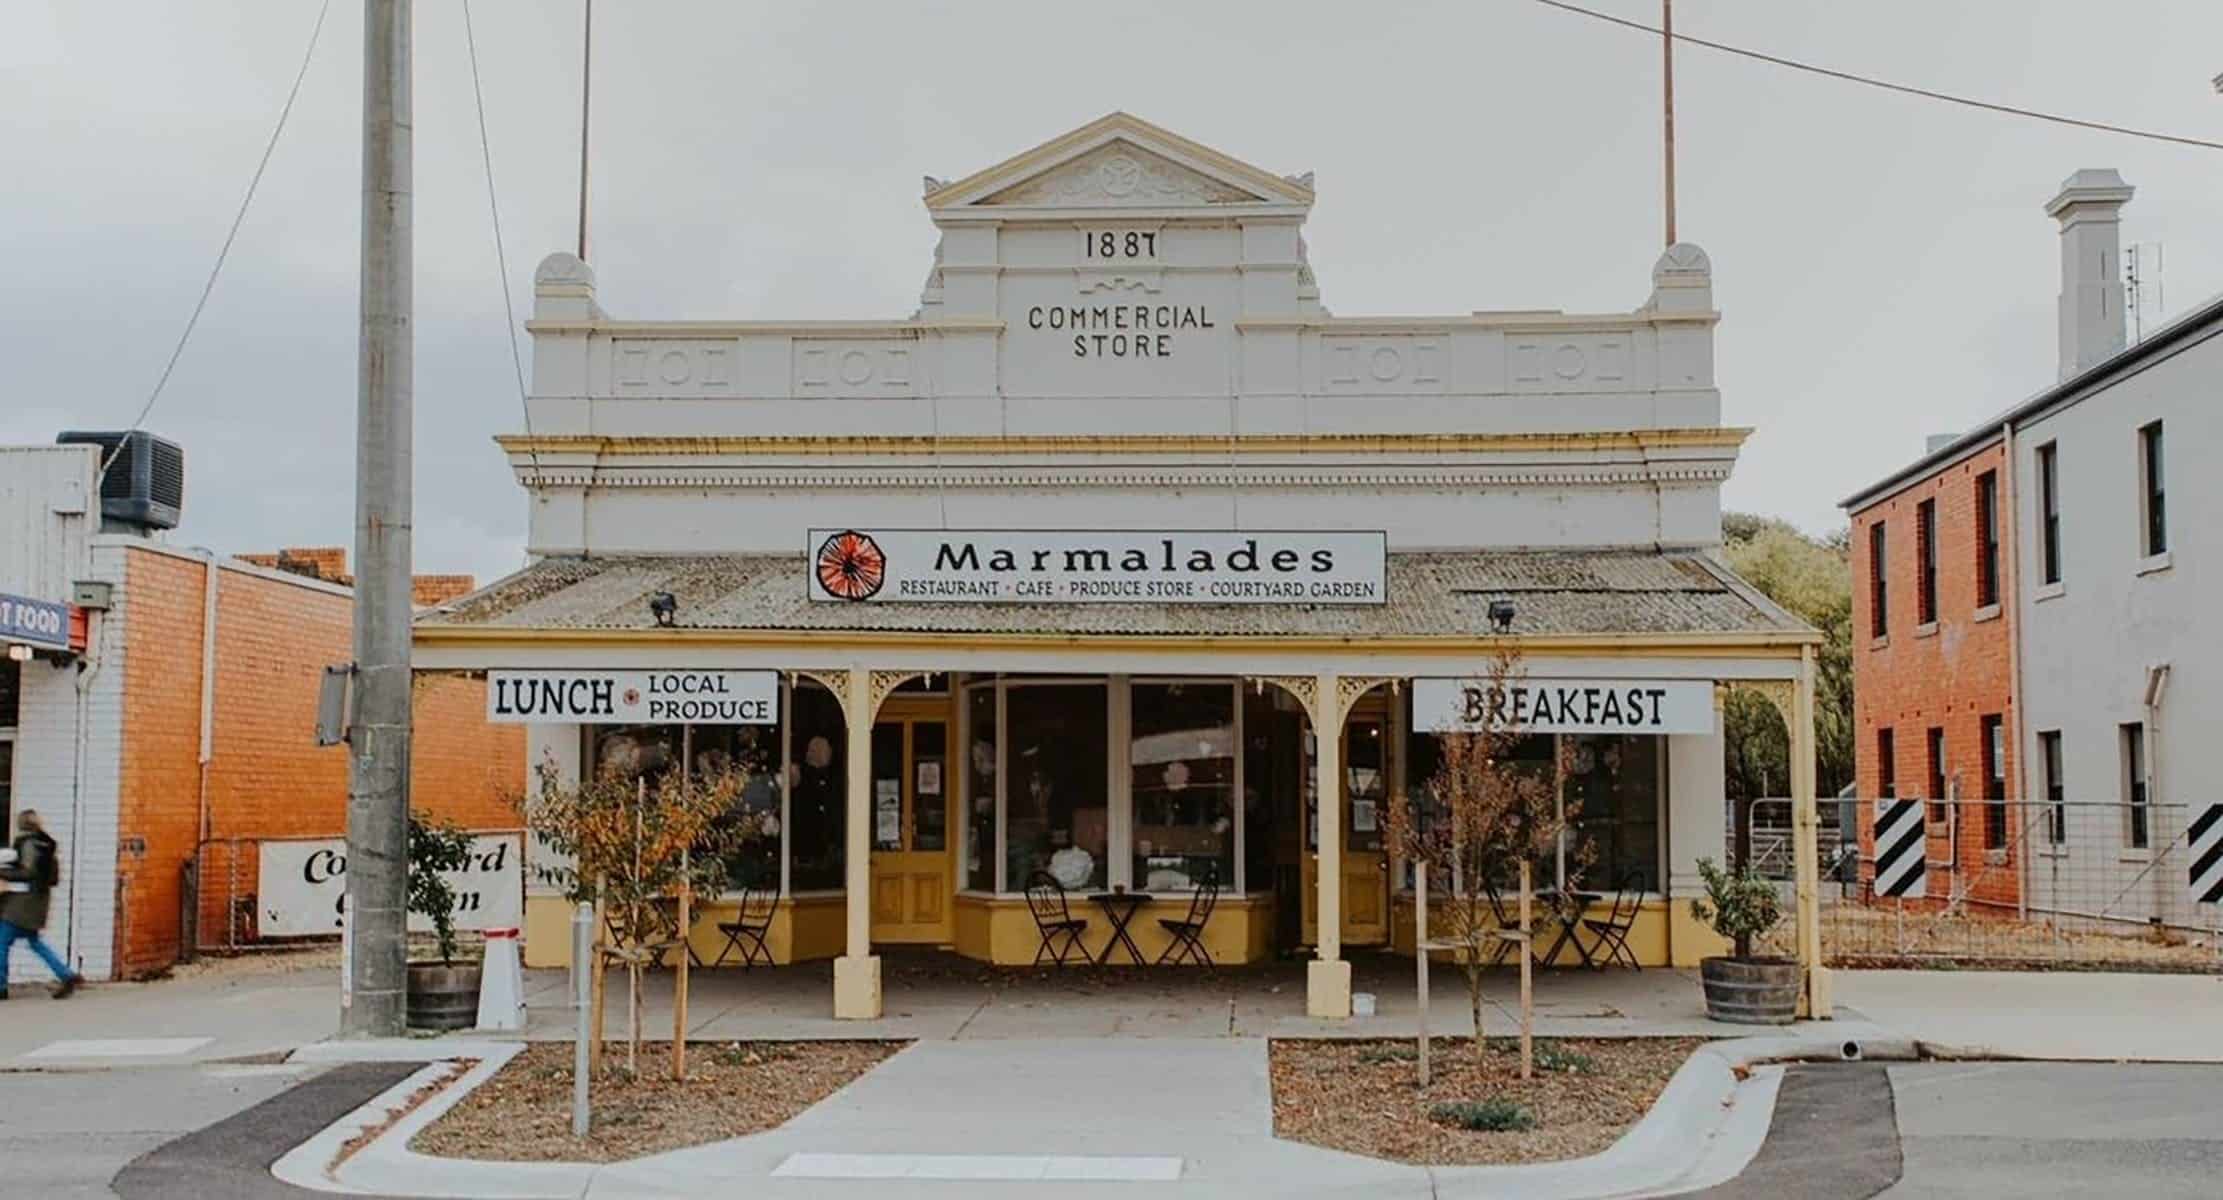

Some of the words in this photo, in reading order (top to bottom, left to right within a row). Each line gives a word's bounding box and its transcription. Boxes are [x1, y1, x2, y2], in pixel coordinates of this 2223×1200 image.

[1087, 232, 1156, 257] 1887
[1028, 306, 1215, 329] COMMERCIAL
[1074, 335, 1172, 357] STORE
[934, 540, 1334, 572] Marmalades
[900, 580, 999, 596] RESTAURANT
[1015, 580, 1053, 596] CAFE
[1070, 580, 1141, 596] PRODUCE
[1146, 581, 1194, 596] STORE
[1210, 581, 1305, 597] COURTYARD
[1310, 582, 1375, 597] GARDEN
[648, 675, 729, 693] LOCAL
[496, 679, 614, 715] LUNCH
[1462, 687, 1666, 726] BREAKFAST
[649, 700, 769, 719] PRODUCE
